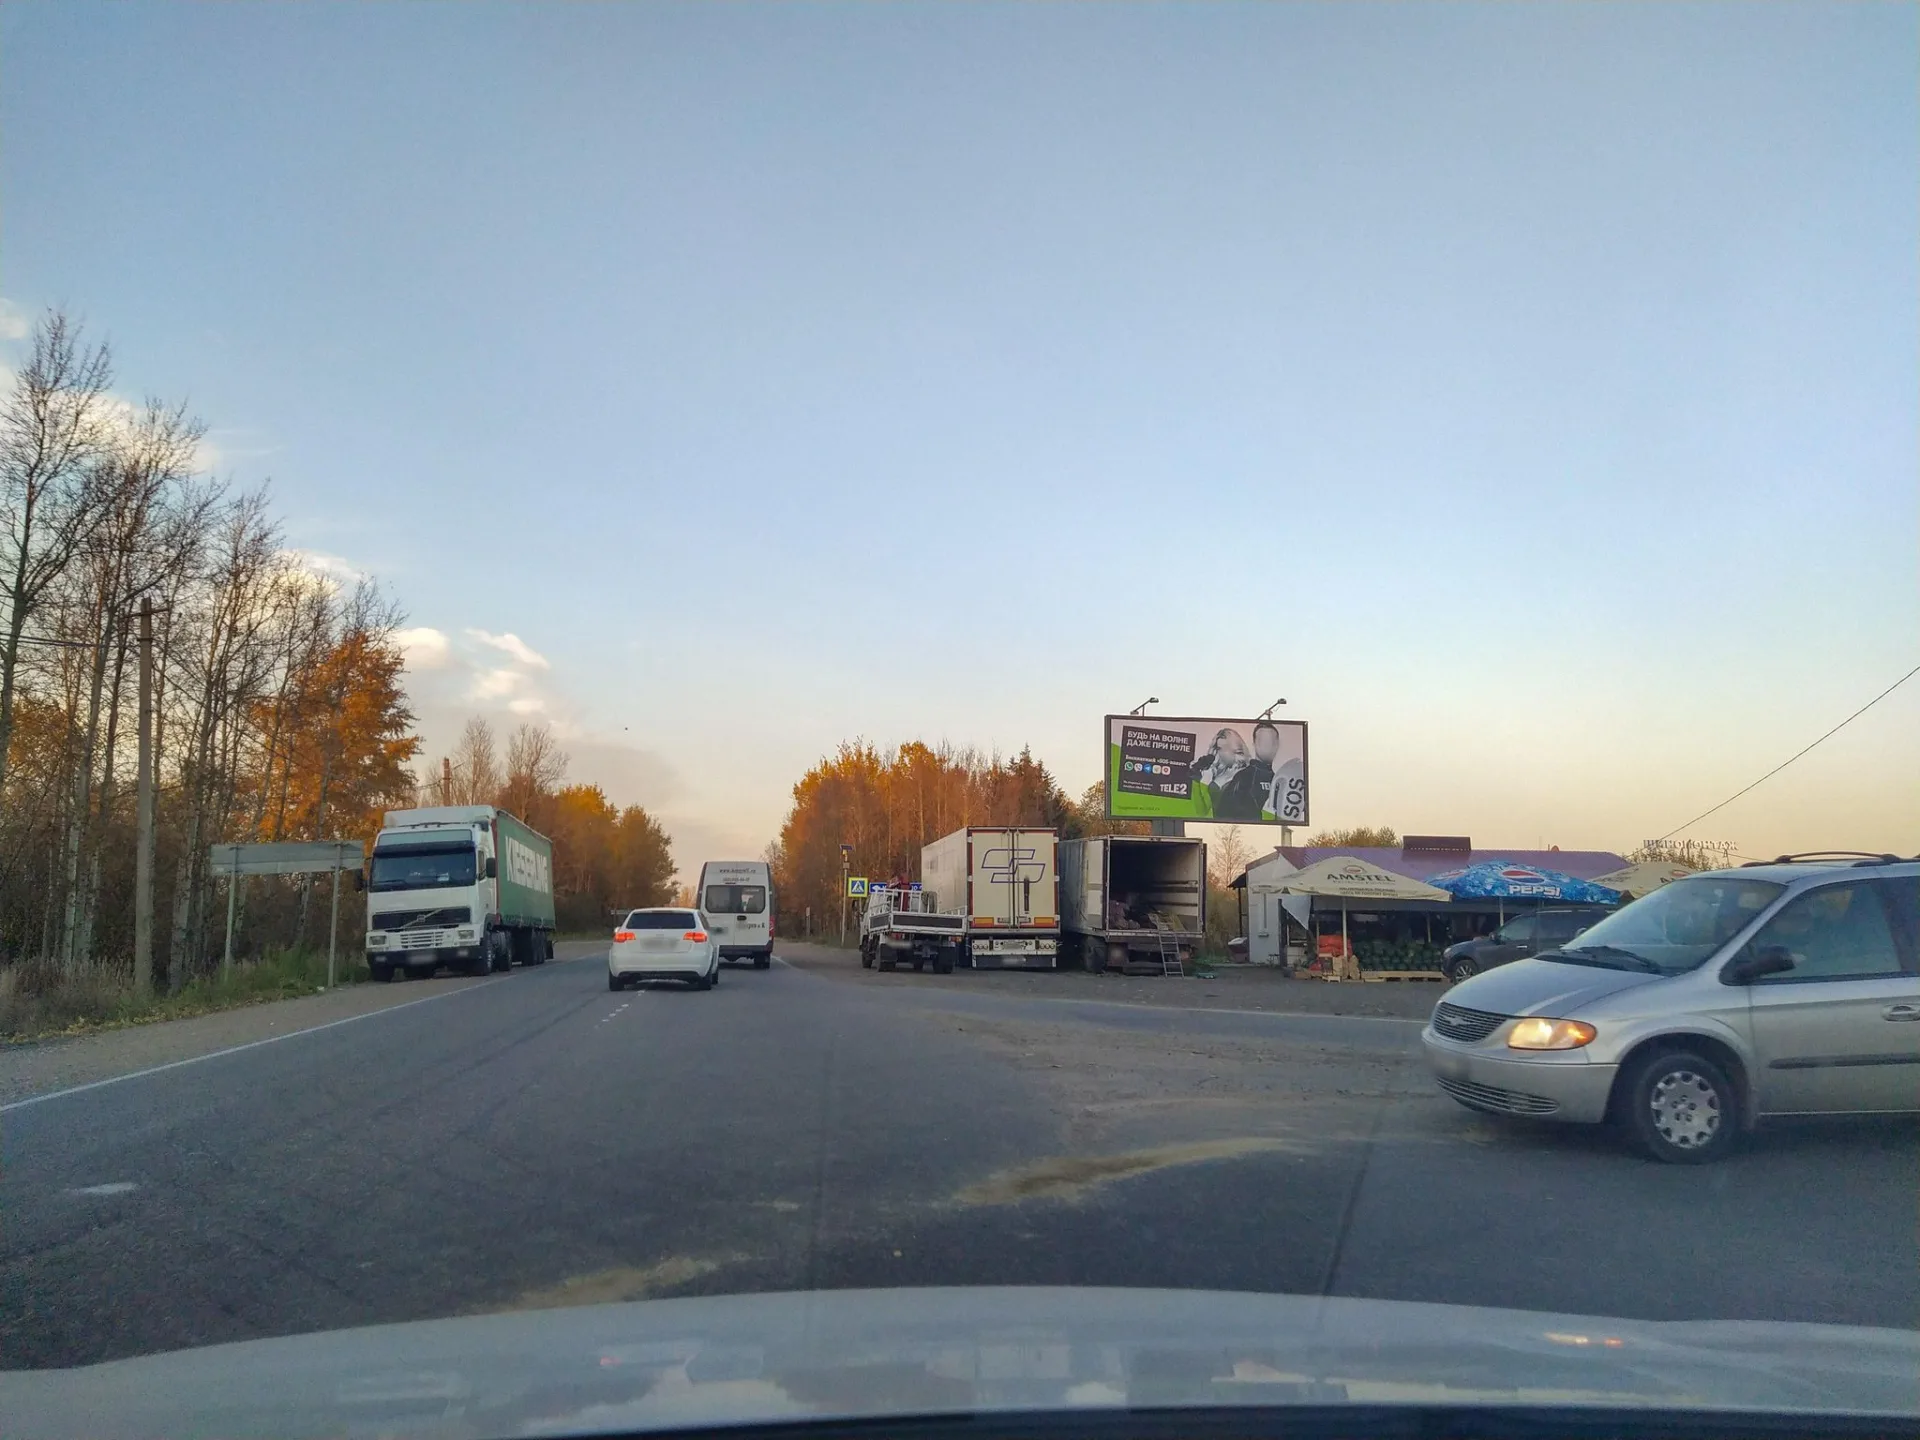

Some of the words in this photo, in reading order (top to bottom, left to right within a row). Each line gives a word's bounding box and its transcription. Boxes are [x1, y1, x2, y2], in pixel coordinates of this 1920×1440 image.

[1127, 730, 1148, 739] БУДЬ
[1162, 735, 1189, 744] ВОЛНЕ
[1126, 739, 1151, 748] ДАЖЕ
[1152, 742, 1168, 750] ПРИ
[1160, 783, 1187, 795] TELE2
[1283, 777, 1304, 819] SOS
[1327, 873, 1395, 882] AMSTEL
[1509, 884, 1561, 898] PEPSI
